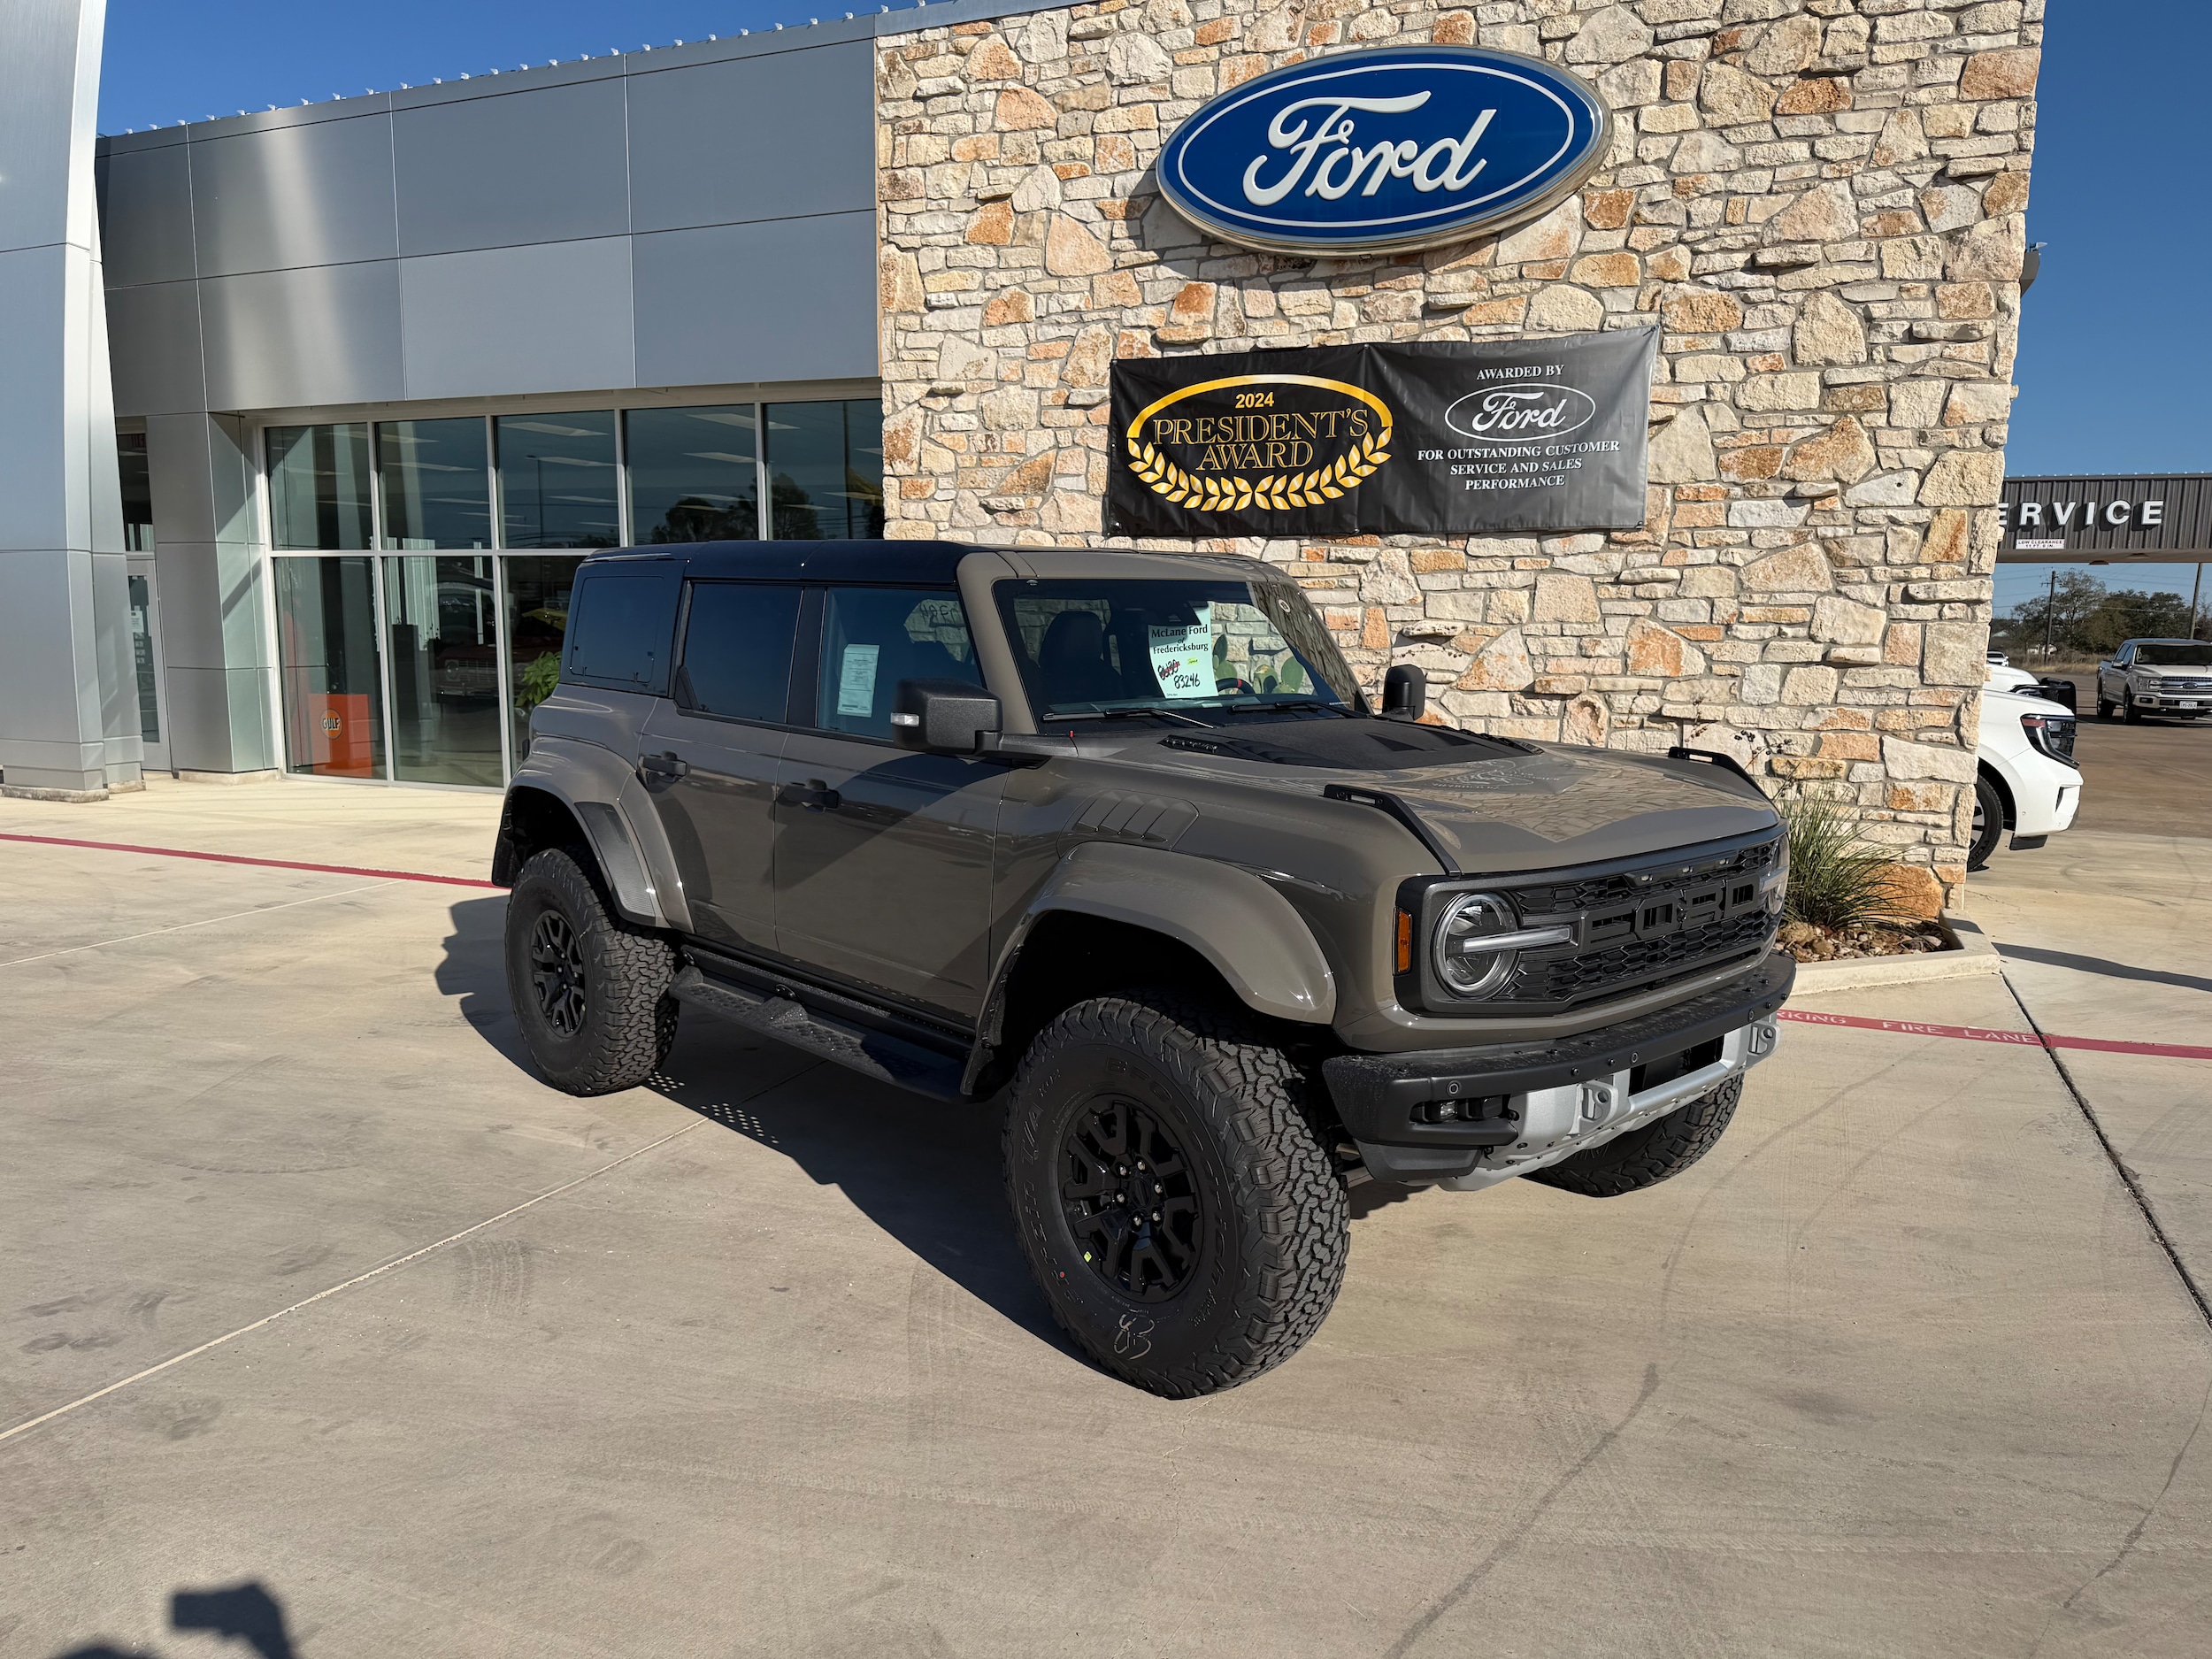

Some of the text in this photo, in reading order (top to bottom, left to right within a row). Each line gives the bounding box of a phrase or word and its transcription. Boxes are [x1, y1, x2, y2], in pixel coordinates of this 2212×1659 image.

[1243, 90, 1497, 206] Ford
[1476, 364, 1565, 380] AWARDED BY
[1235, 392, 1275, 409] 2024
[1471, 391, 1568, 432] Ford
[1152, 407, 1369, 445] PRESIDENT'S
[1195, 441, 1314, 471] AWARD
[1417, 441, 1620, 461] FOR OUTSTANDING CUSTOMER
[1450, 458, 1582, 475] SERVICE AND SALES
[1464, 475, 1566, 490] PERFORMANCE
[1151, 624, 1208, 638] McLane Ford
[1153, 643, 1209, 654] Fredericksburg
[1173, 672, 1201, 689] 83246
[322, 717, 340, 729] GULF
[1580, 873, 1760, 953] FORD
[1882, 1020, 1944, 1034] FIRE
[1963, 1028, 2041, 1043] LANE
